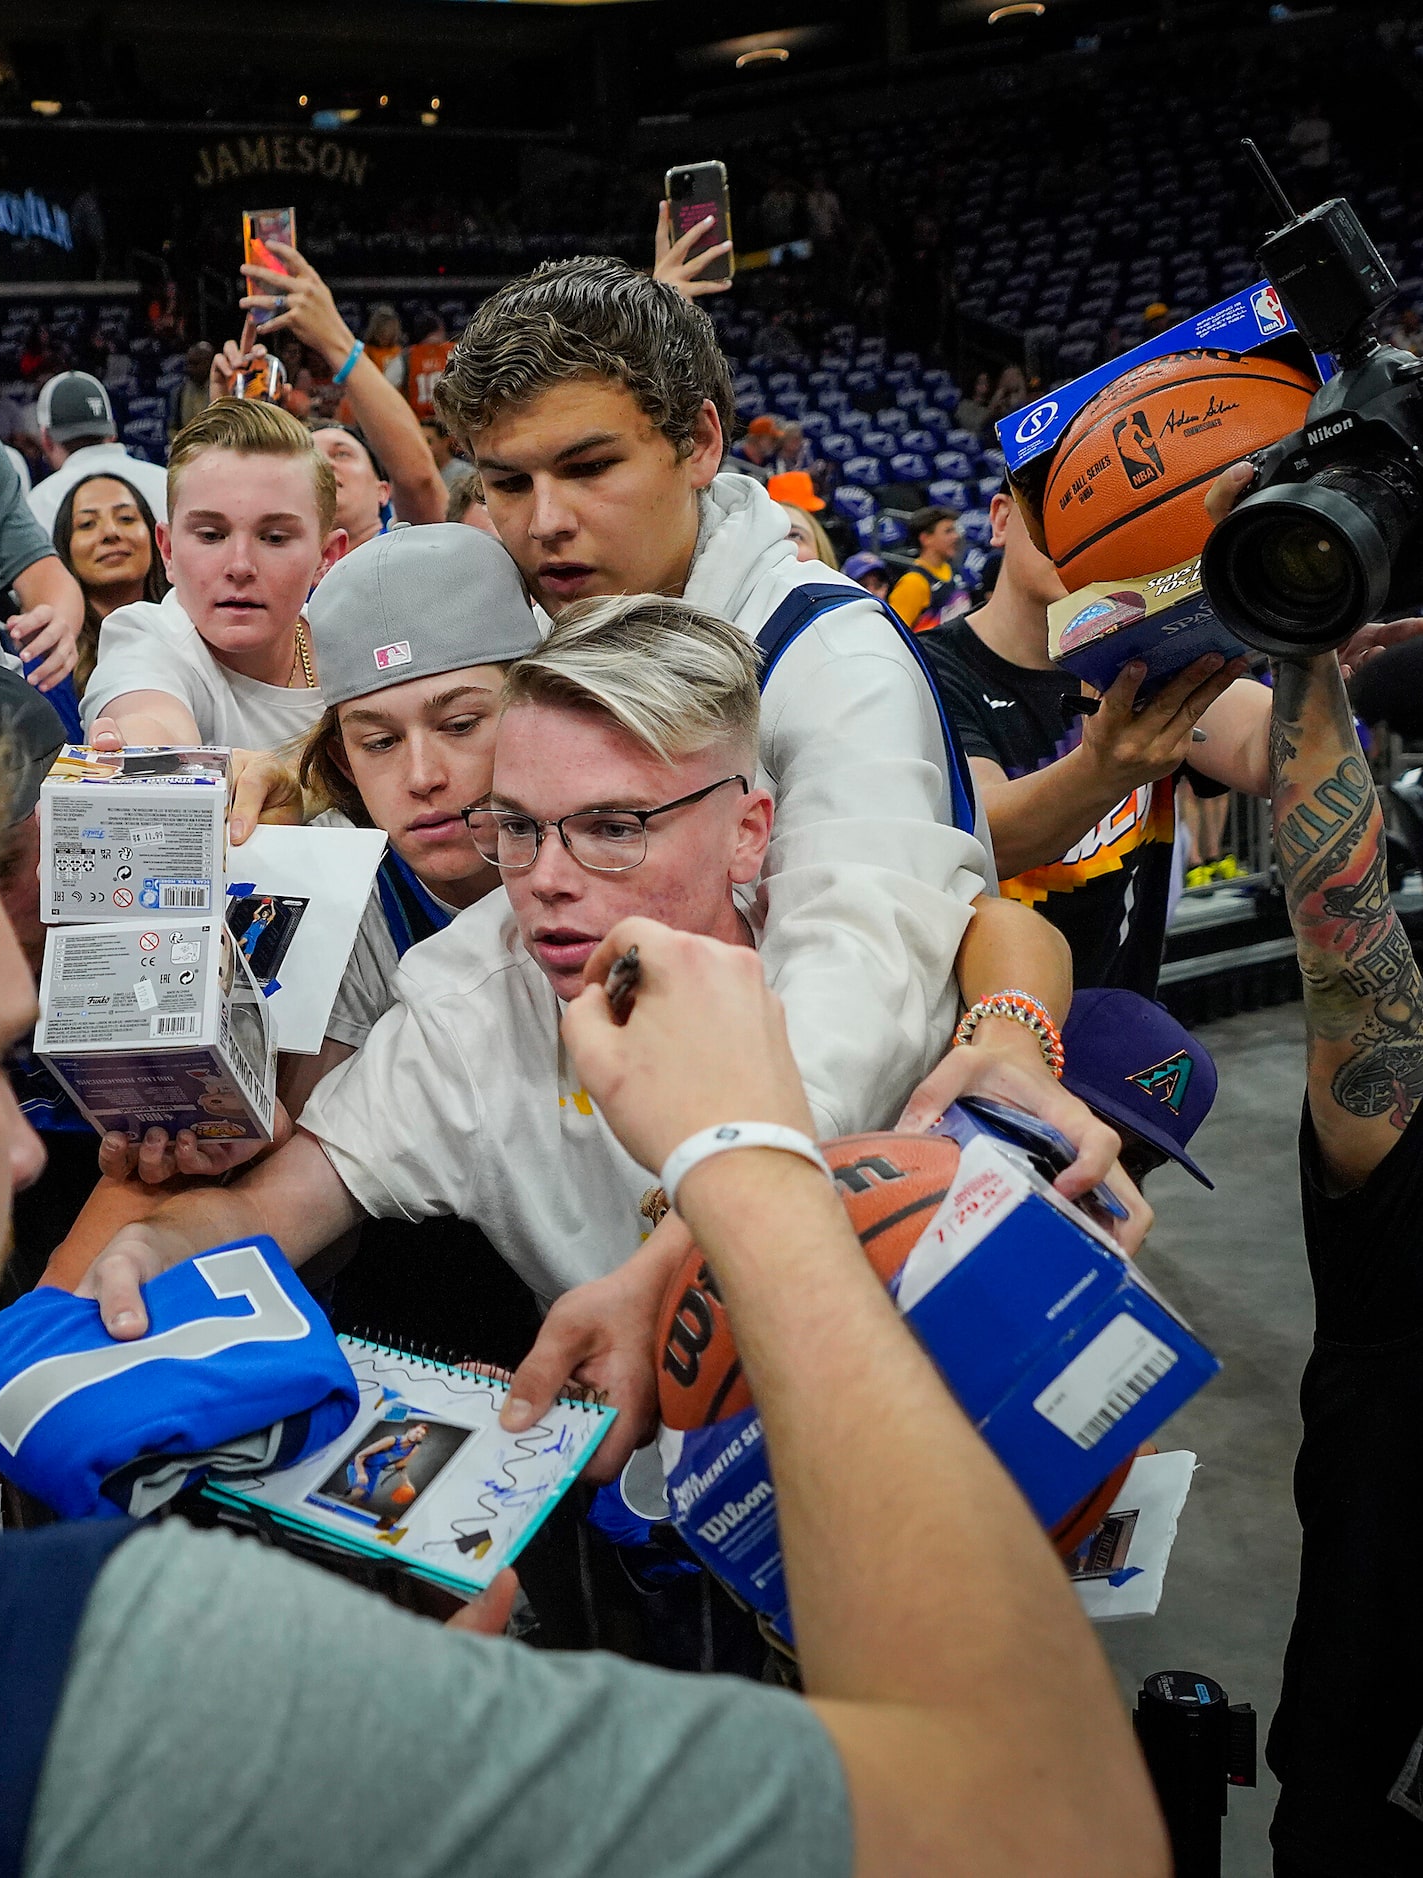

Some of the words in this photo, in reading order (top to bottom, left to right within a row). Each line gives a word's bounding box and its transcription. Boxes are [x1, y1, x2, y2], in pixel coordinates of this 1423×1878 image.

[193, 135, 369, 187] JAMESON
[1194, 321, 1212, 331] THE
[1212, 305, 1246, 324] OFFICIAL
[1195, 309, 1247, 336] BASKETBALL
[1196, 306, 1233, 326] SPALDING
[1199, 330, 1210, 339] OF
[1212, 323, 1227, 332] THE
[1228, 314, 1246, 325] NBA
[1263, 321, 1280, 333] NBA
[1307, 417, 1354, 446] Nikon
[1059, 487, 1073, 511] GAME
[1072, 475, 1088, 495] BALL
[1086, 455, 1112, 481] SERIES
[1132, 467, 1155, 486] NBA
[1143, 566, 1192, 592] Stays
[1154, 577, 1189, 597] 10x
[81, 829, 105, 840] Funko
[87, 996, 111, 1007] Funko
[697, 1479, 773, 1545] Wilson
